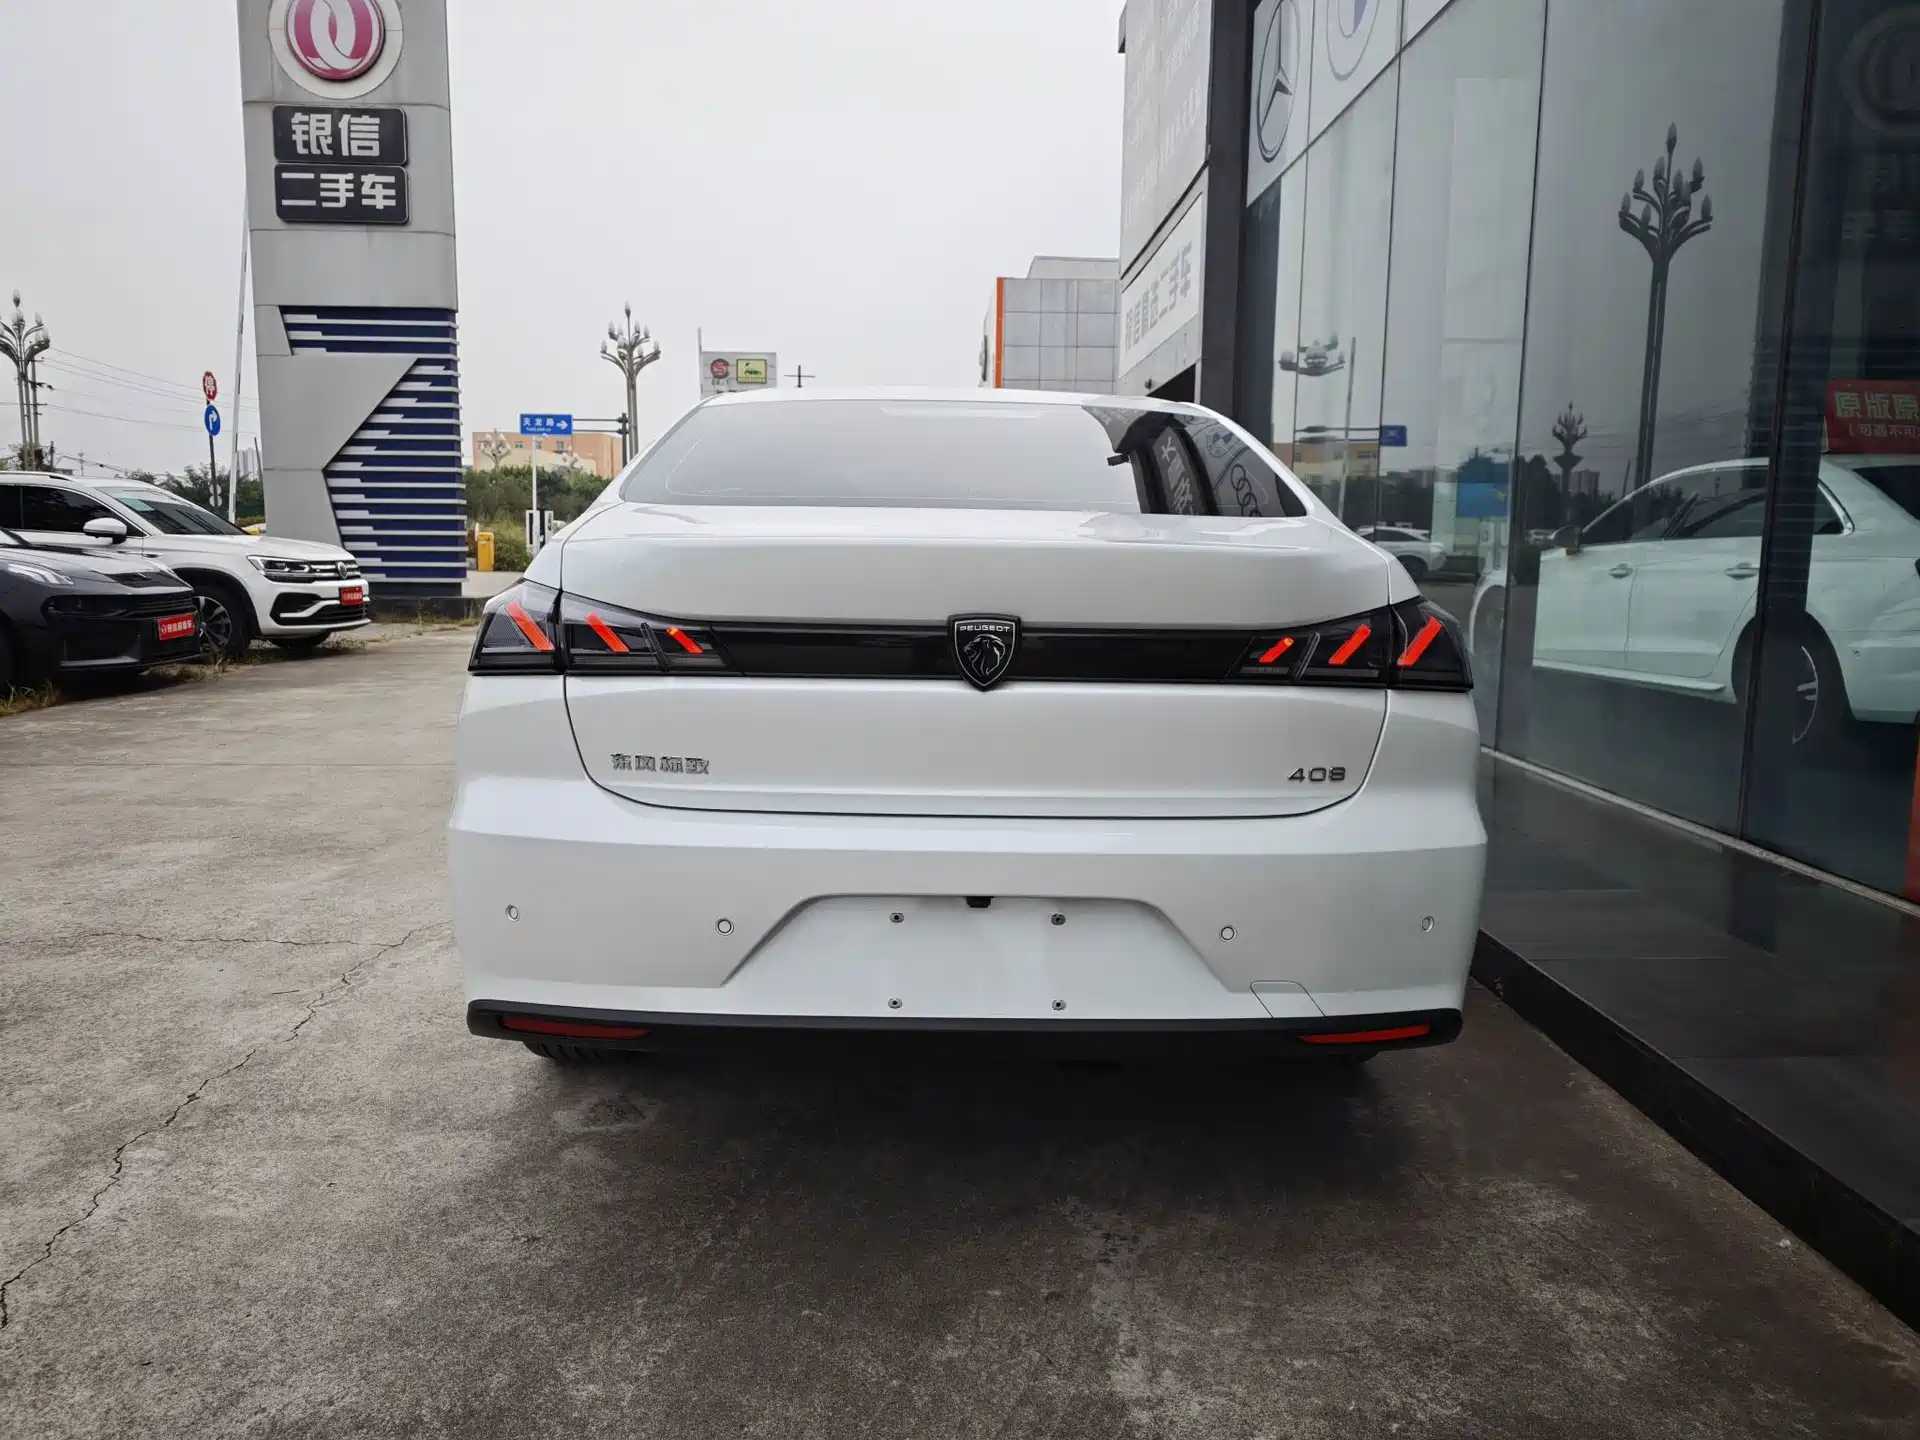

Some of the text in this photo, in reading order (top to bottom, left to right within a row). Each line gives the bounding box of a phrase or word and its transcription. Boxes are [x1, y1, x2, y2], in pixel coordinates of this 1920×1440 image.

[290, 112, 380, 156] 银信
[281, 172, 396, 209] 二手车
[960, 624, 1010, 632] PEUGEOT
[610, 753, 710, 775] 东风标致
[1287, 766, 1346, 783] 408
